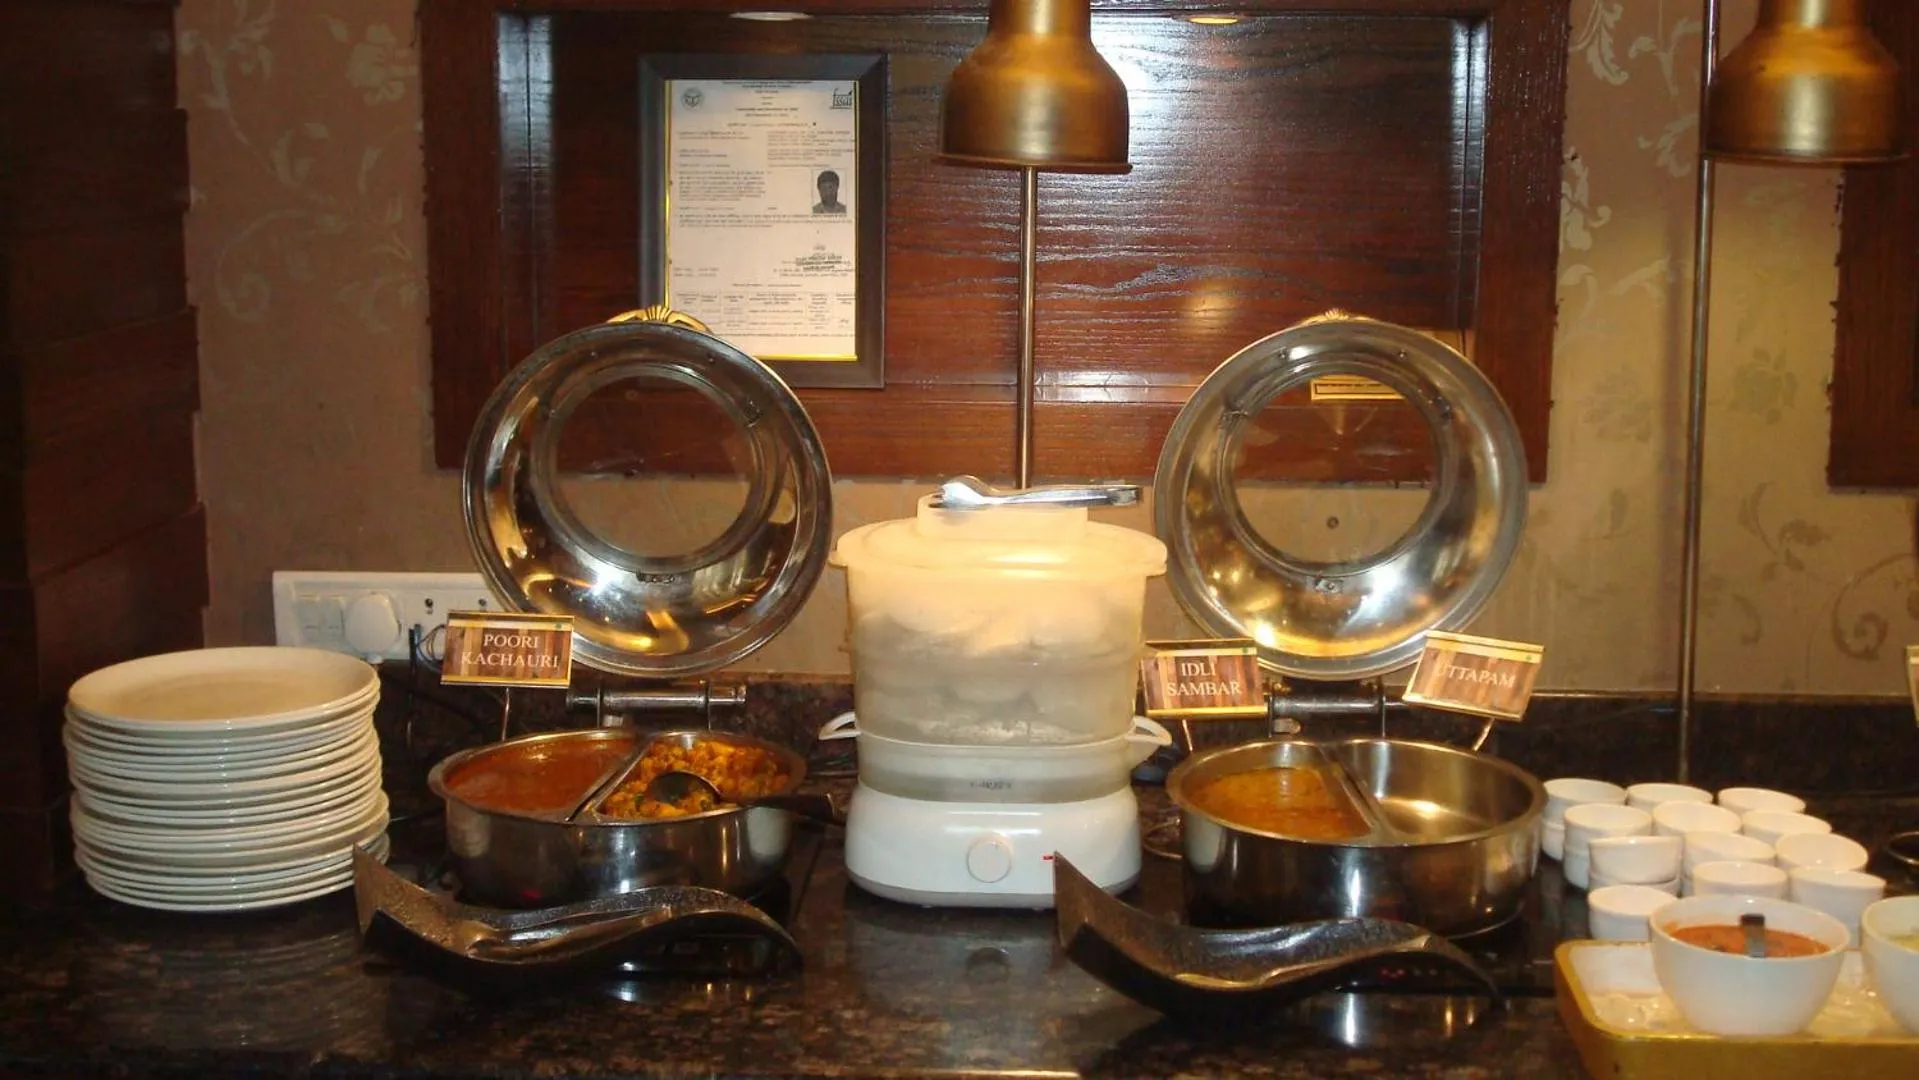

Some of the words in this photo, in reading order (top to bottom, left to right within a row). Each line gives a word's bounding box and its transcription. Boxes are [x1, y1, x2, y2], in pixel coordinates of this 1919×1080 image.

[483, 633, 540, 649] POORI
[461, 651, 560, 669] KACHAURI
[1181, 662, 1217, 677] IDLI
[1167, 681, 1241, 696] SAMBAR
